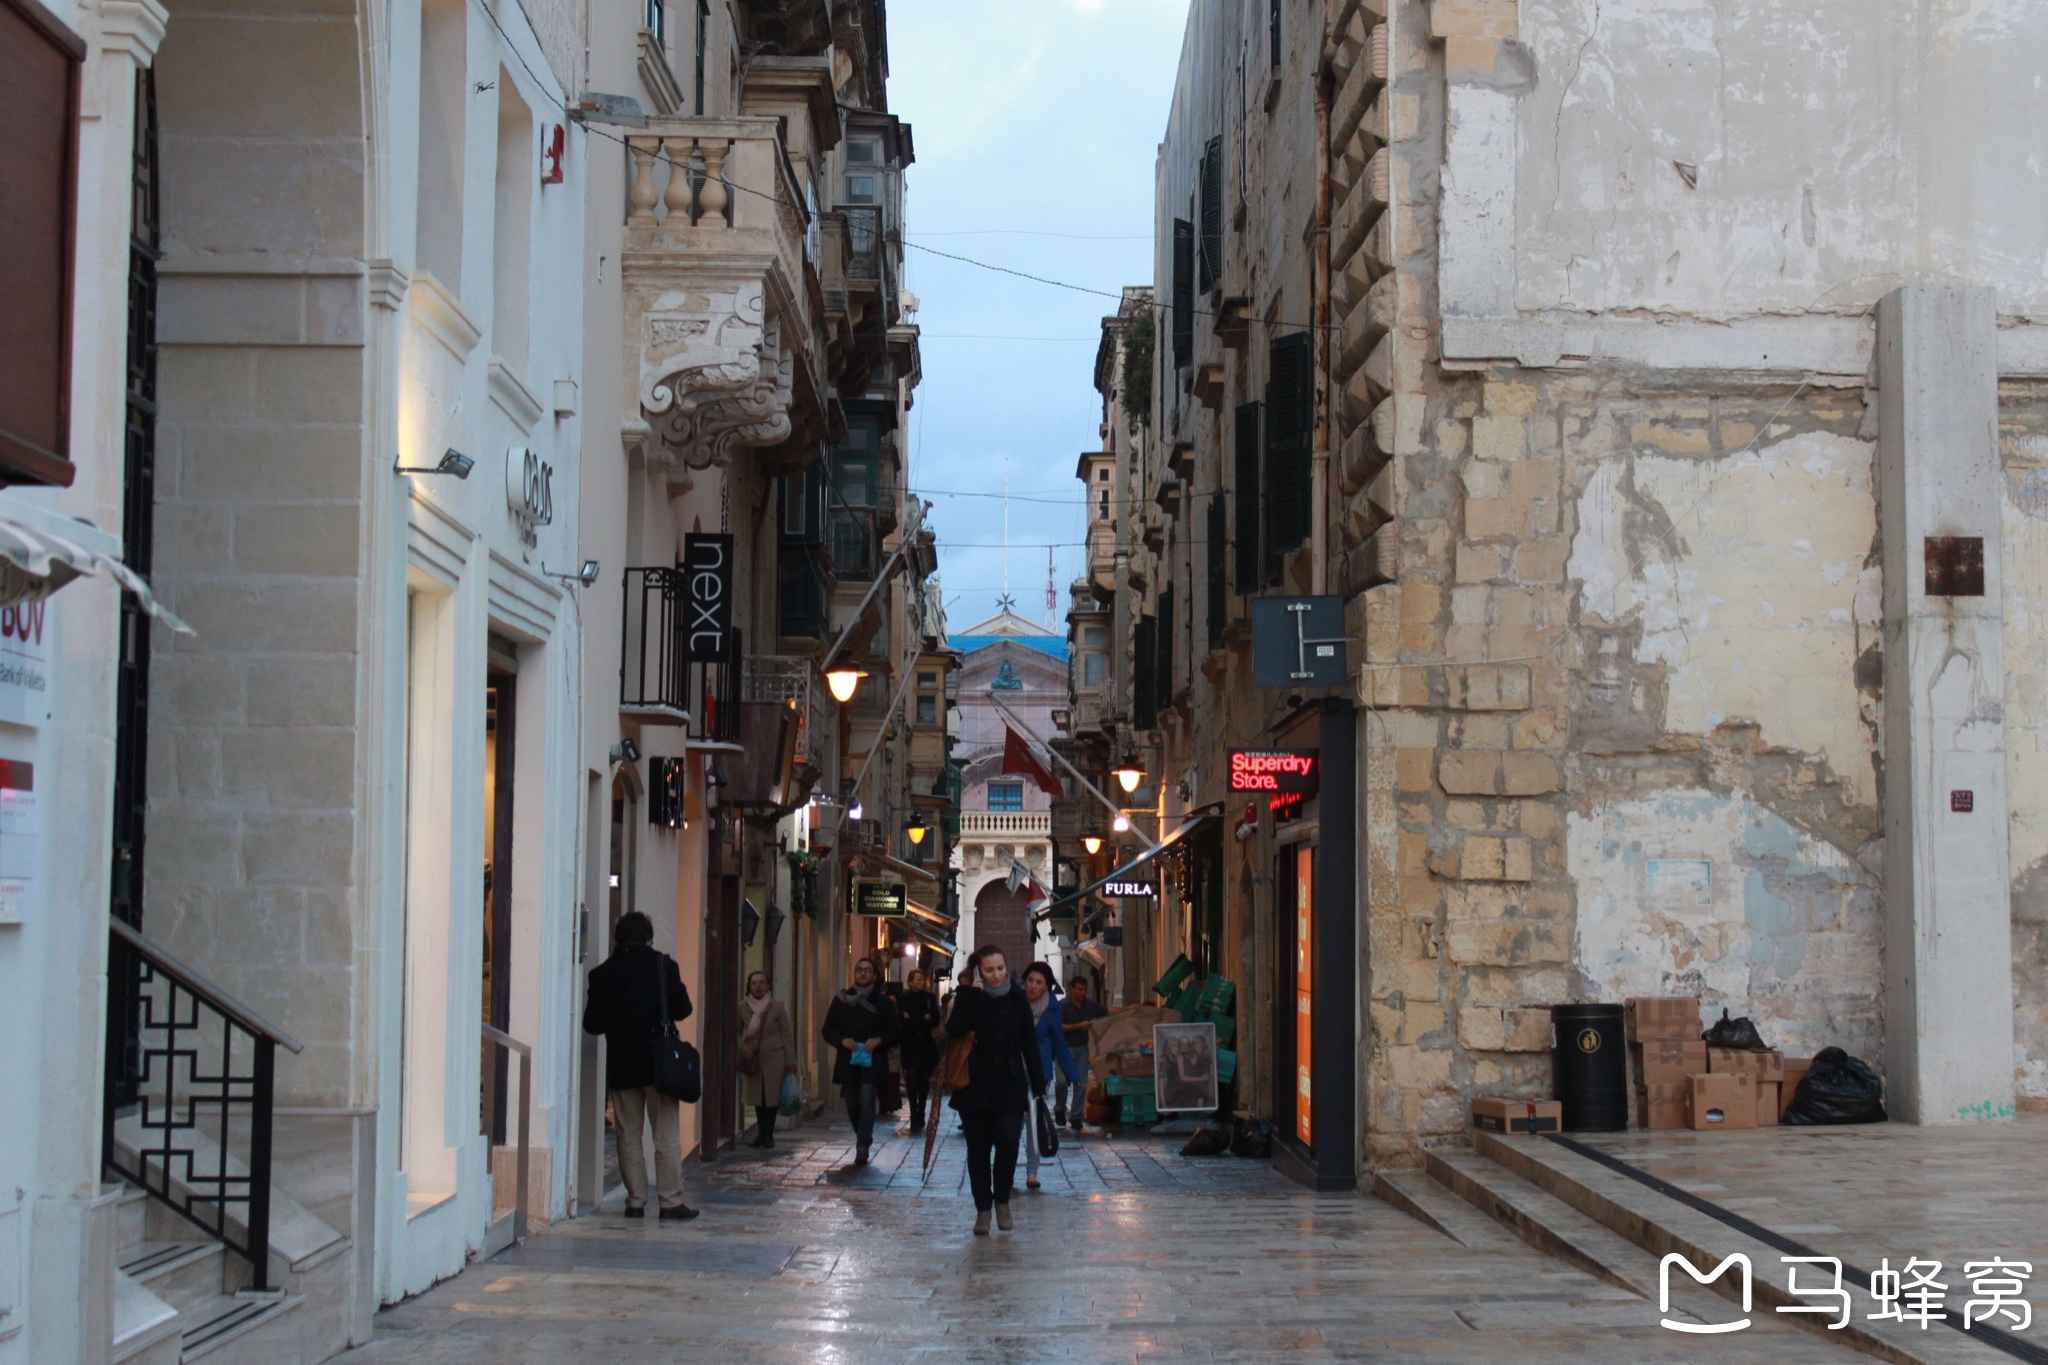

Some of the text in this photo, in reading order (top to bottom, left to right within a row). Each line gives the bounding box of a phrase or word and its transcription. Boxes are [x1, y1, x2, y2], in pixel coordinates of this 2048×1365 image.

[690, 543, 723, 652] next
[1232, 753, 1312, 776] Superdry
[1232, 771, 1278, 789] Store.
[1105, 882, 1152, 895] FURLA
